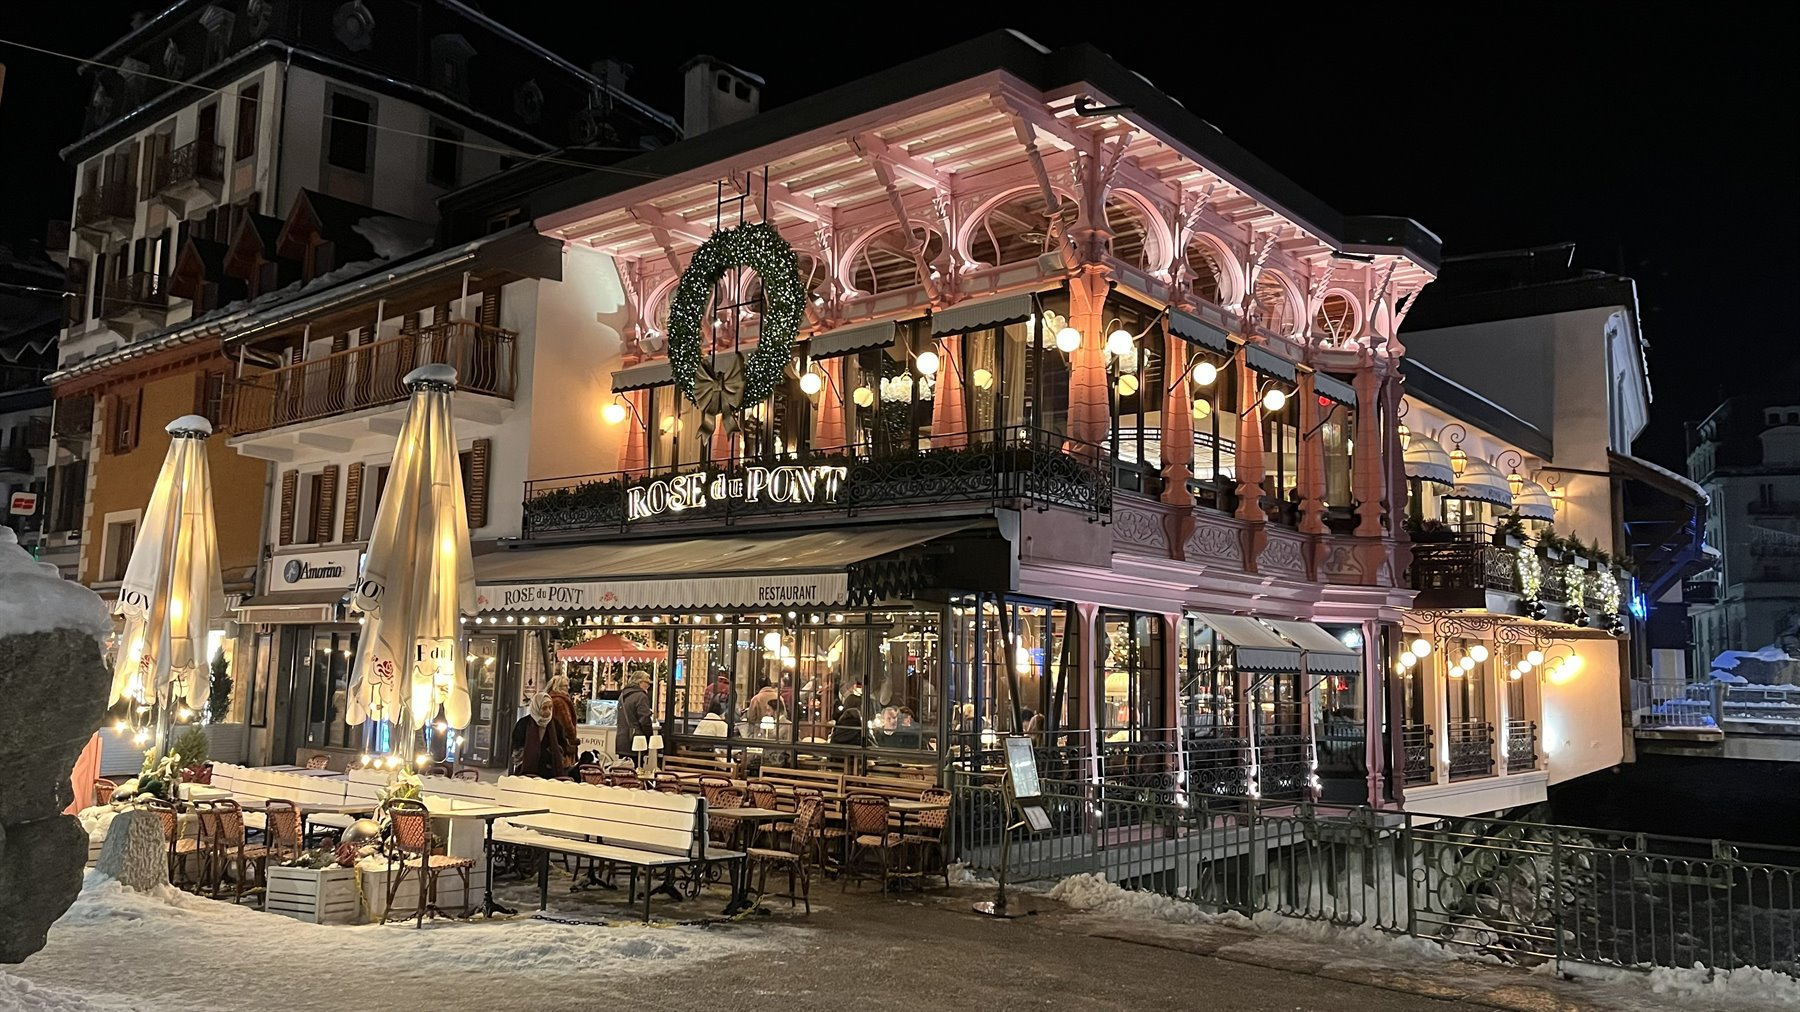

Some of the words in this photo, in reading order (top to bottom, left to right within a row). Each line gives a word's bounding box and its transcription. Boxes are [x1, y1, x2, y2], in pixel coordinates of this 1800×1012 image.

[627, 472, 707, 522] ROSE
[710, 474, 743, 500] du
[745, 466, 848, 504] PONT
[300, 561, 344, 579] Amorino
[504, 587, 535, 606] ROSE
[536, 588, 547, 599] du
[548, 586, 584, 605] PONT
[758, 585, 817, 601] RESTAURANT
